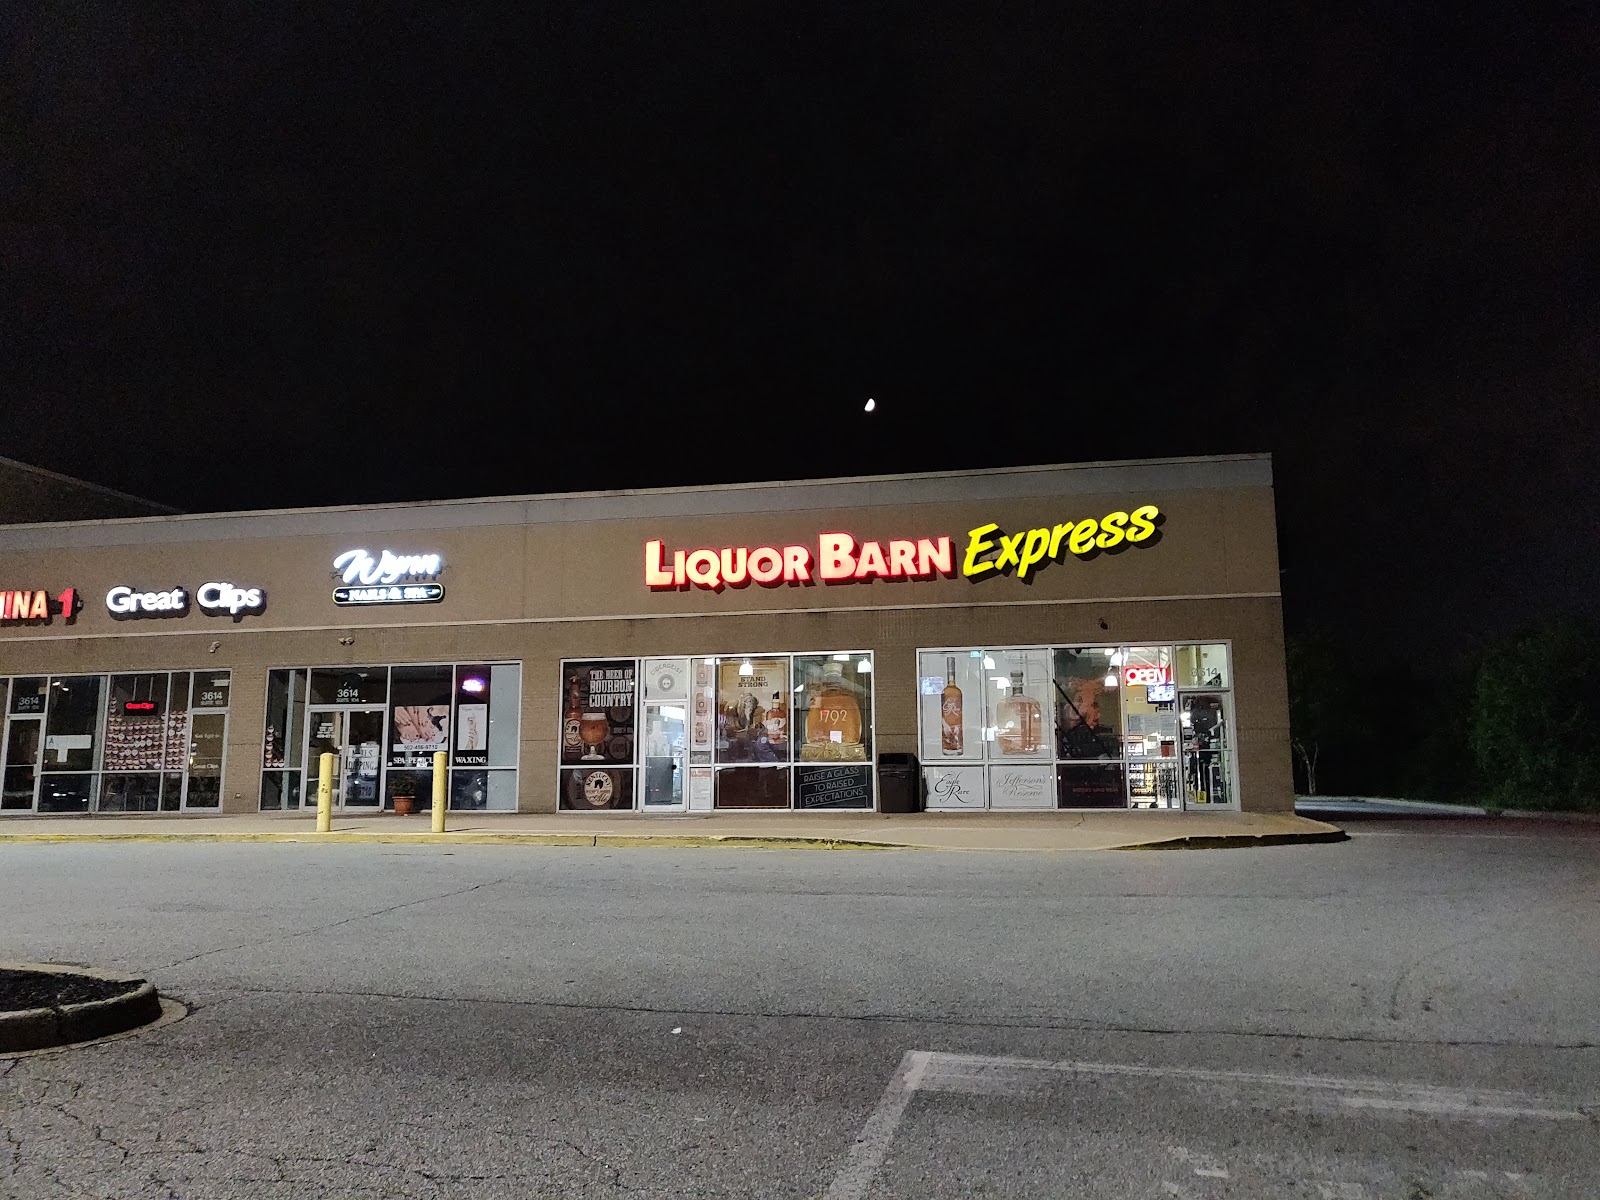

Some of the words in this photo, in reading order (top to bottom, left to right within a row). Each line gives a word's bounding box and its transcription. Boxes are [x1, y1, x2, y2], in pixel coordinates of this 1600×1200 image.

[645, 539, 810, 588] LIQUOR
[818, 531, 951, 580] BARN
[963, 505, 1159, 578] Express
[333, 549, 440, 584] Wynn
[106, 586, 185, 612] Great
[196, 582, 261, 614] Clips
[348, 588, 387, 601] NAILS
[404, 587, 428, 599] SPA
[58, 588, 74, 618] 1
[590, 669, 604, 680] THE
[605, 669, 623, 680] BEER
[624, 669, 633, 680] OF
[1126, 668, 1166, 685] OPEN
[337, 688, 359, 697] 3614
[589, 679, 633, 693] BOURBON
[19, 697, 39, 706] 3614
[201, 692, 223, 701] 3614
[588, 693, 633, 708] COUNTRY
[820, 709, 848, 726] 1792
[455, 756, 487, 764] WAXING
[803, 771, 826, 783] RAISE
[826, 770, 833, 779] A
[833, 766, 860, 777] GLASS
[814, 783, 826, 793] TO
[826, 778, 855, 790] RAISED
[805, 787, 864, 805] EXPECTATIONS
